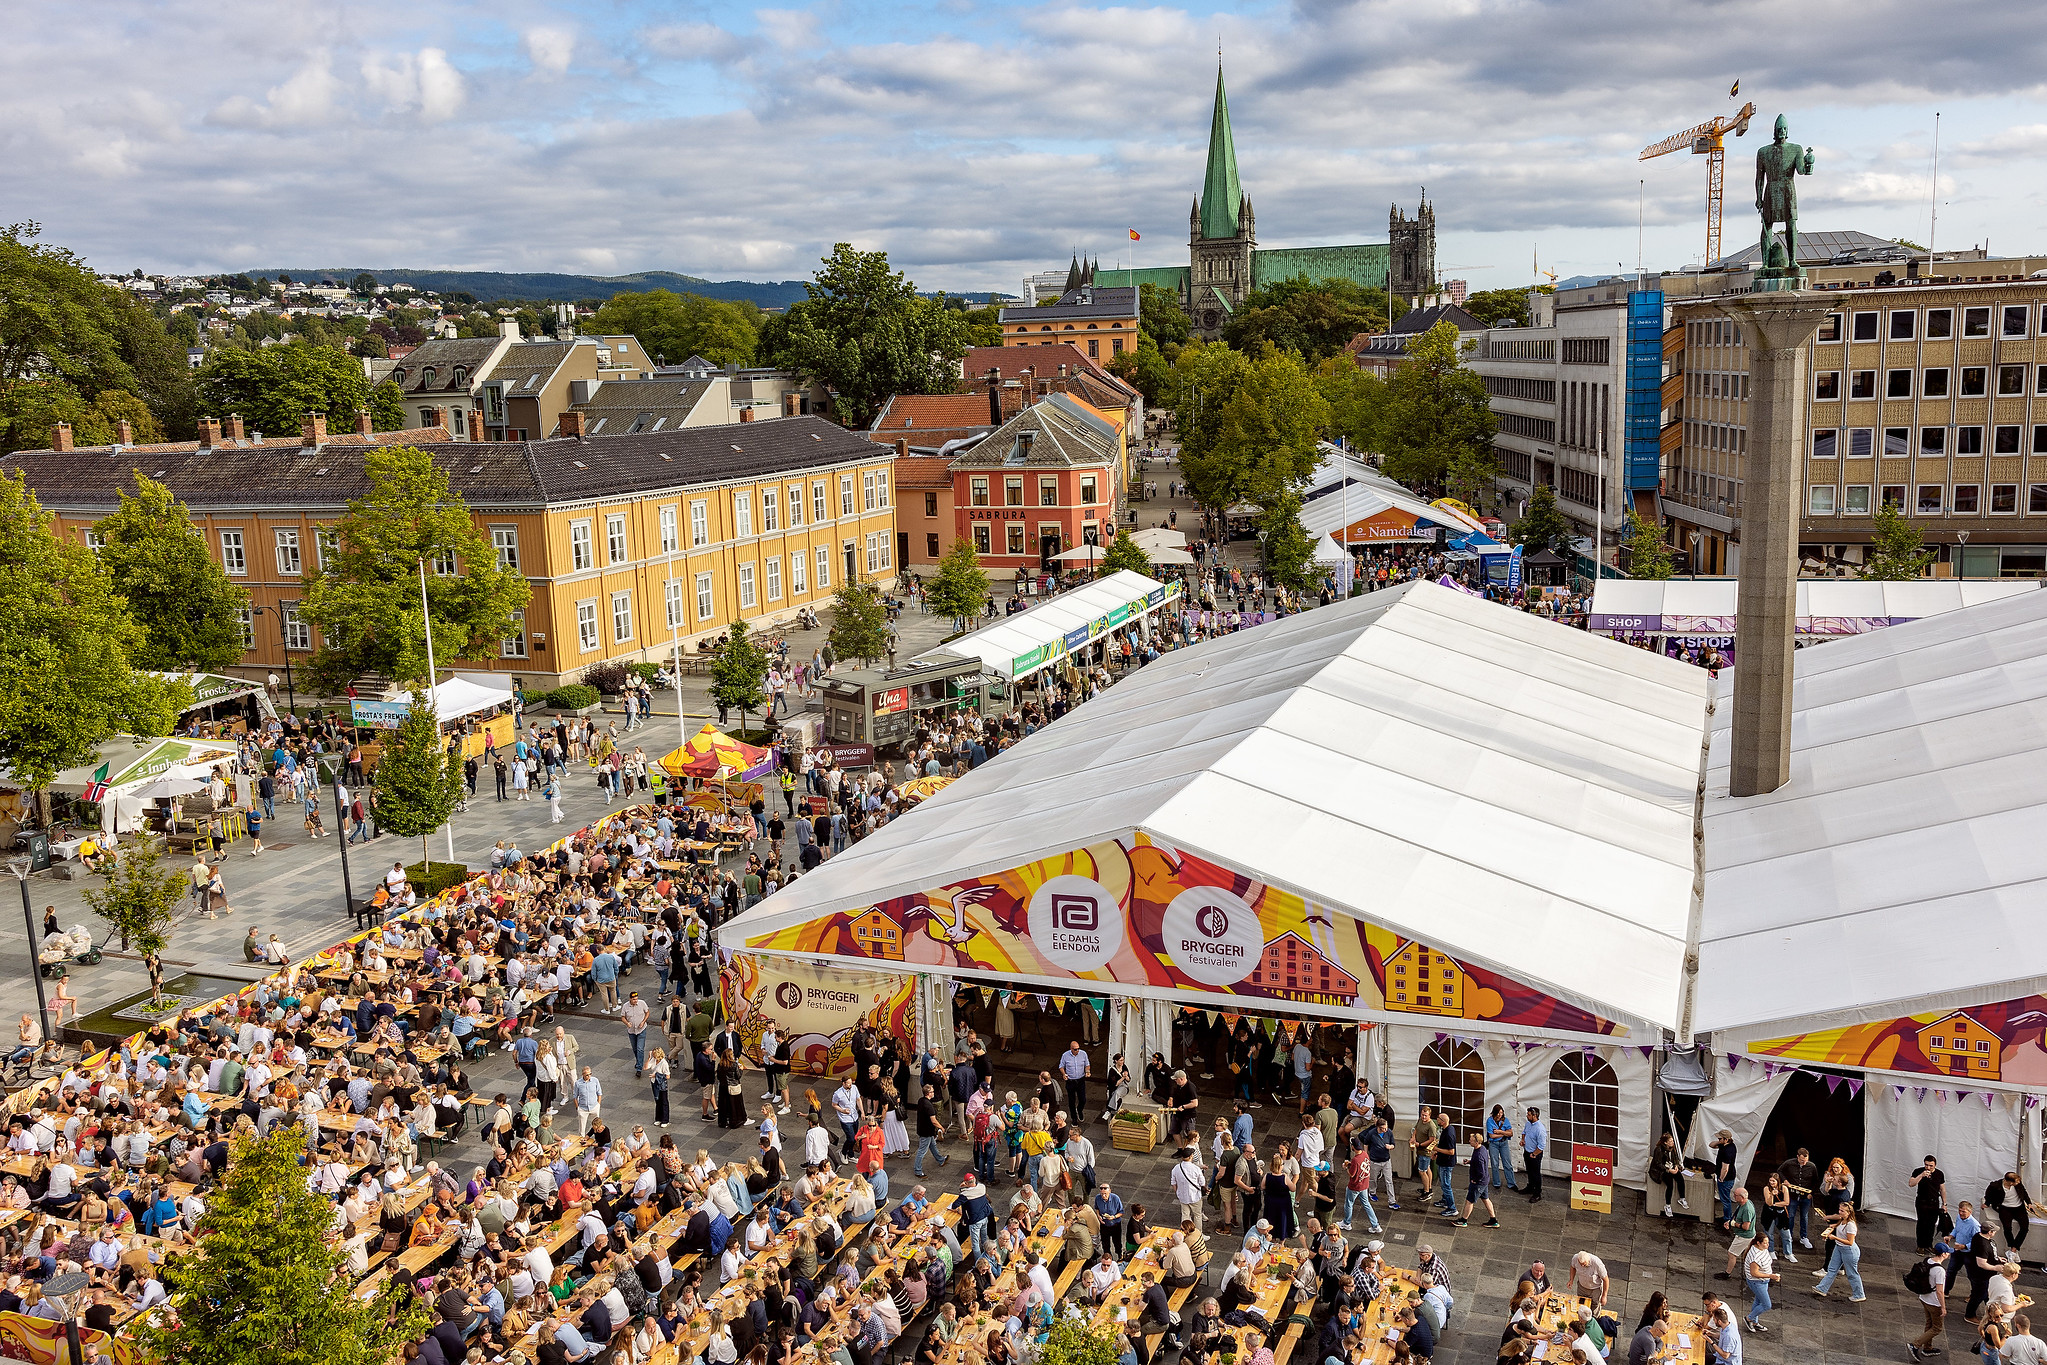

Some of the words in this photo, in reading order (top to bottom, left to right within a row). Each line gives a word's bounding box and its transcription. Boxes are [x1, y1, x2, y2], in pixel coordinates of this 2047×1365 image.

[969, 511, 1026, 520] SABRURA
[1369, 525, 1431, 538] Namdalen
[1510, 558, 1520, 591] LIERNE
[1607, 618, 1642, 627] SHOP
[1686, 637, 1732, 648] SHOP
[198, 685, 227, 699] Frosta
[878, 691, 902, 706] Una
[354, 711, 382, 720] FROSTA'S
[834, 748, 867, 756] BRYGGERI
[147, 754, 200, 775] Innherred
[1052, 933, 1058, 941] E
[1060, 933, 1067, 942] C
[1068, 934, 1100, 944] DAHLS
[1052, 942, 1100, 952] EIENDOM
[1181, 939, 1244, 957] BRYGGERI
[1189, 954, 1238, 968] festivalen
[807, 988, 859, 1004] BRYGGERI
[807, 1000, 847, 1012] festivalen
[1576, 1155, 1609, 1164] BREWERIES
[1575, 1164, 1608, 1177] 16-30
